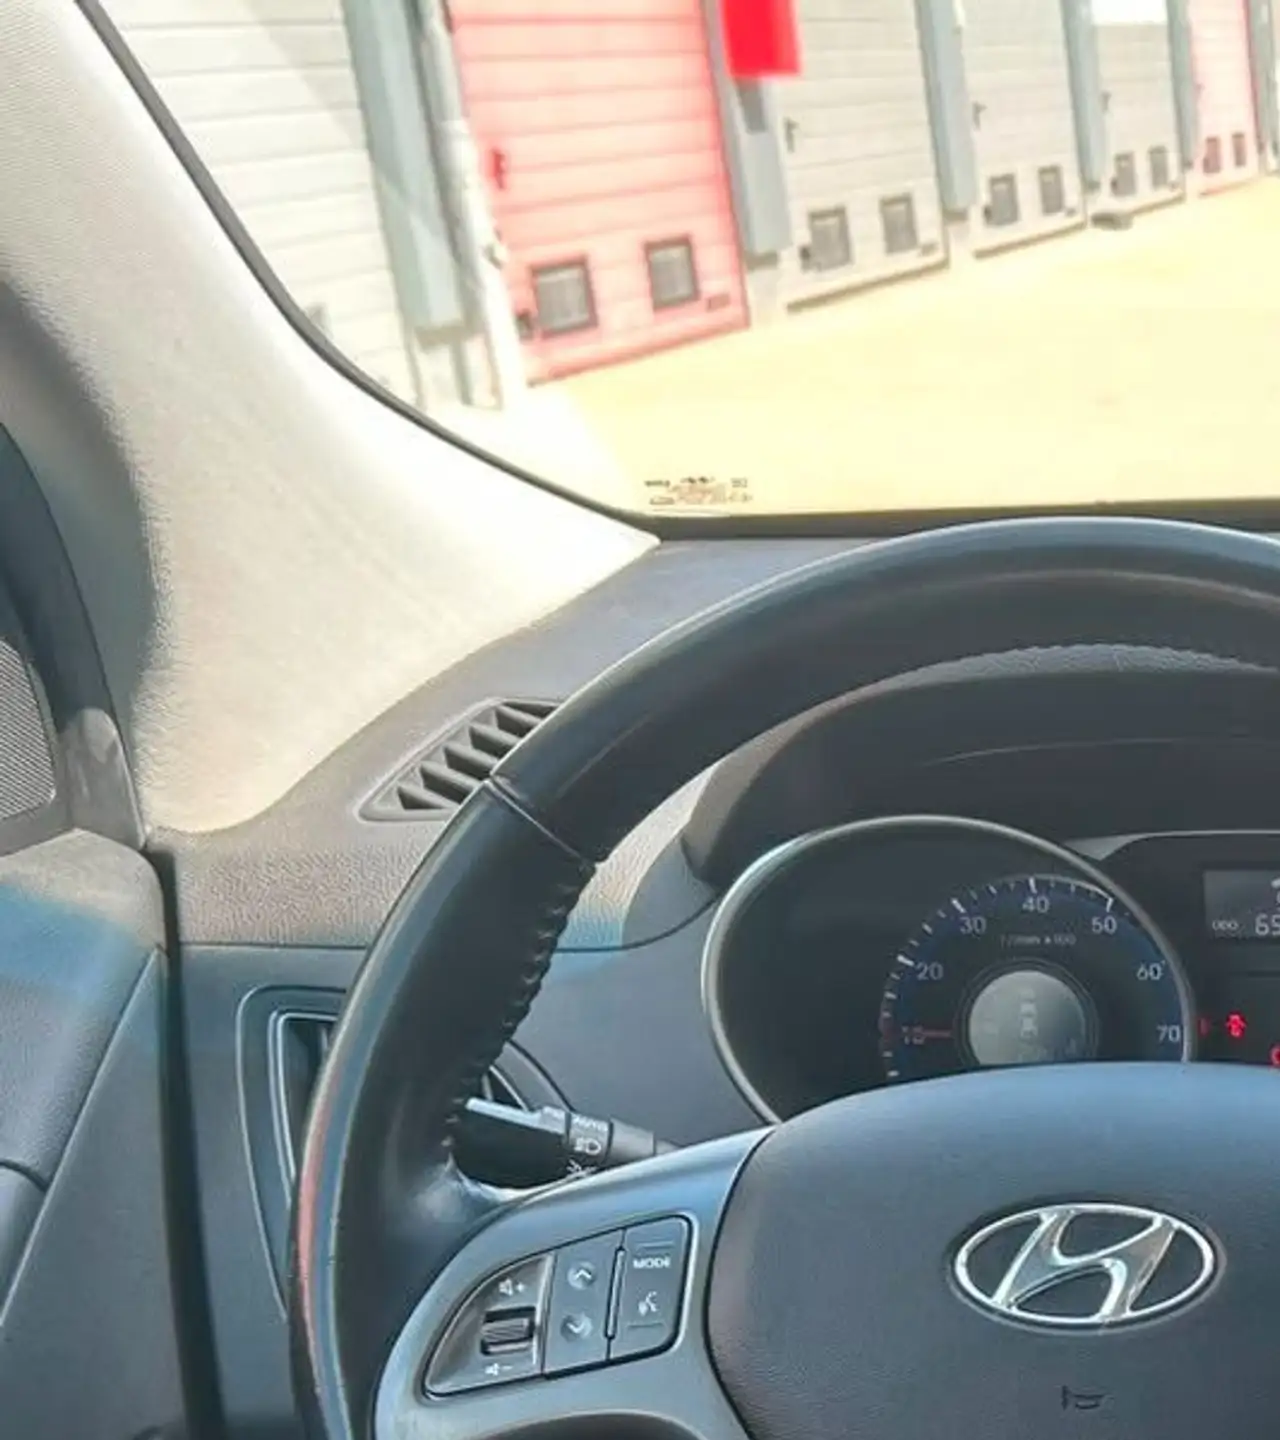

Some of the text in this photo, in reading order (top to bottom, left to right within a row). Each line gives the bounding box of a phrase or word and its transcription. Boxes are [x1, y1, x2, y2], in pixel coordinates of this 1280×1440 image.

[1022, 896, 1050, 913] 40
[960, 917, 986, 933] 30
[1091, 915, 1118, 934] 50
[915, 962, 943, 980] 20
[1137, 964, 1162, 981] 60
[1157, 1026, 1181, 1043] 70
